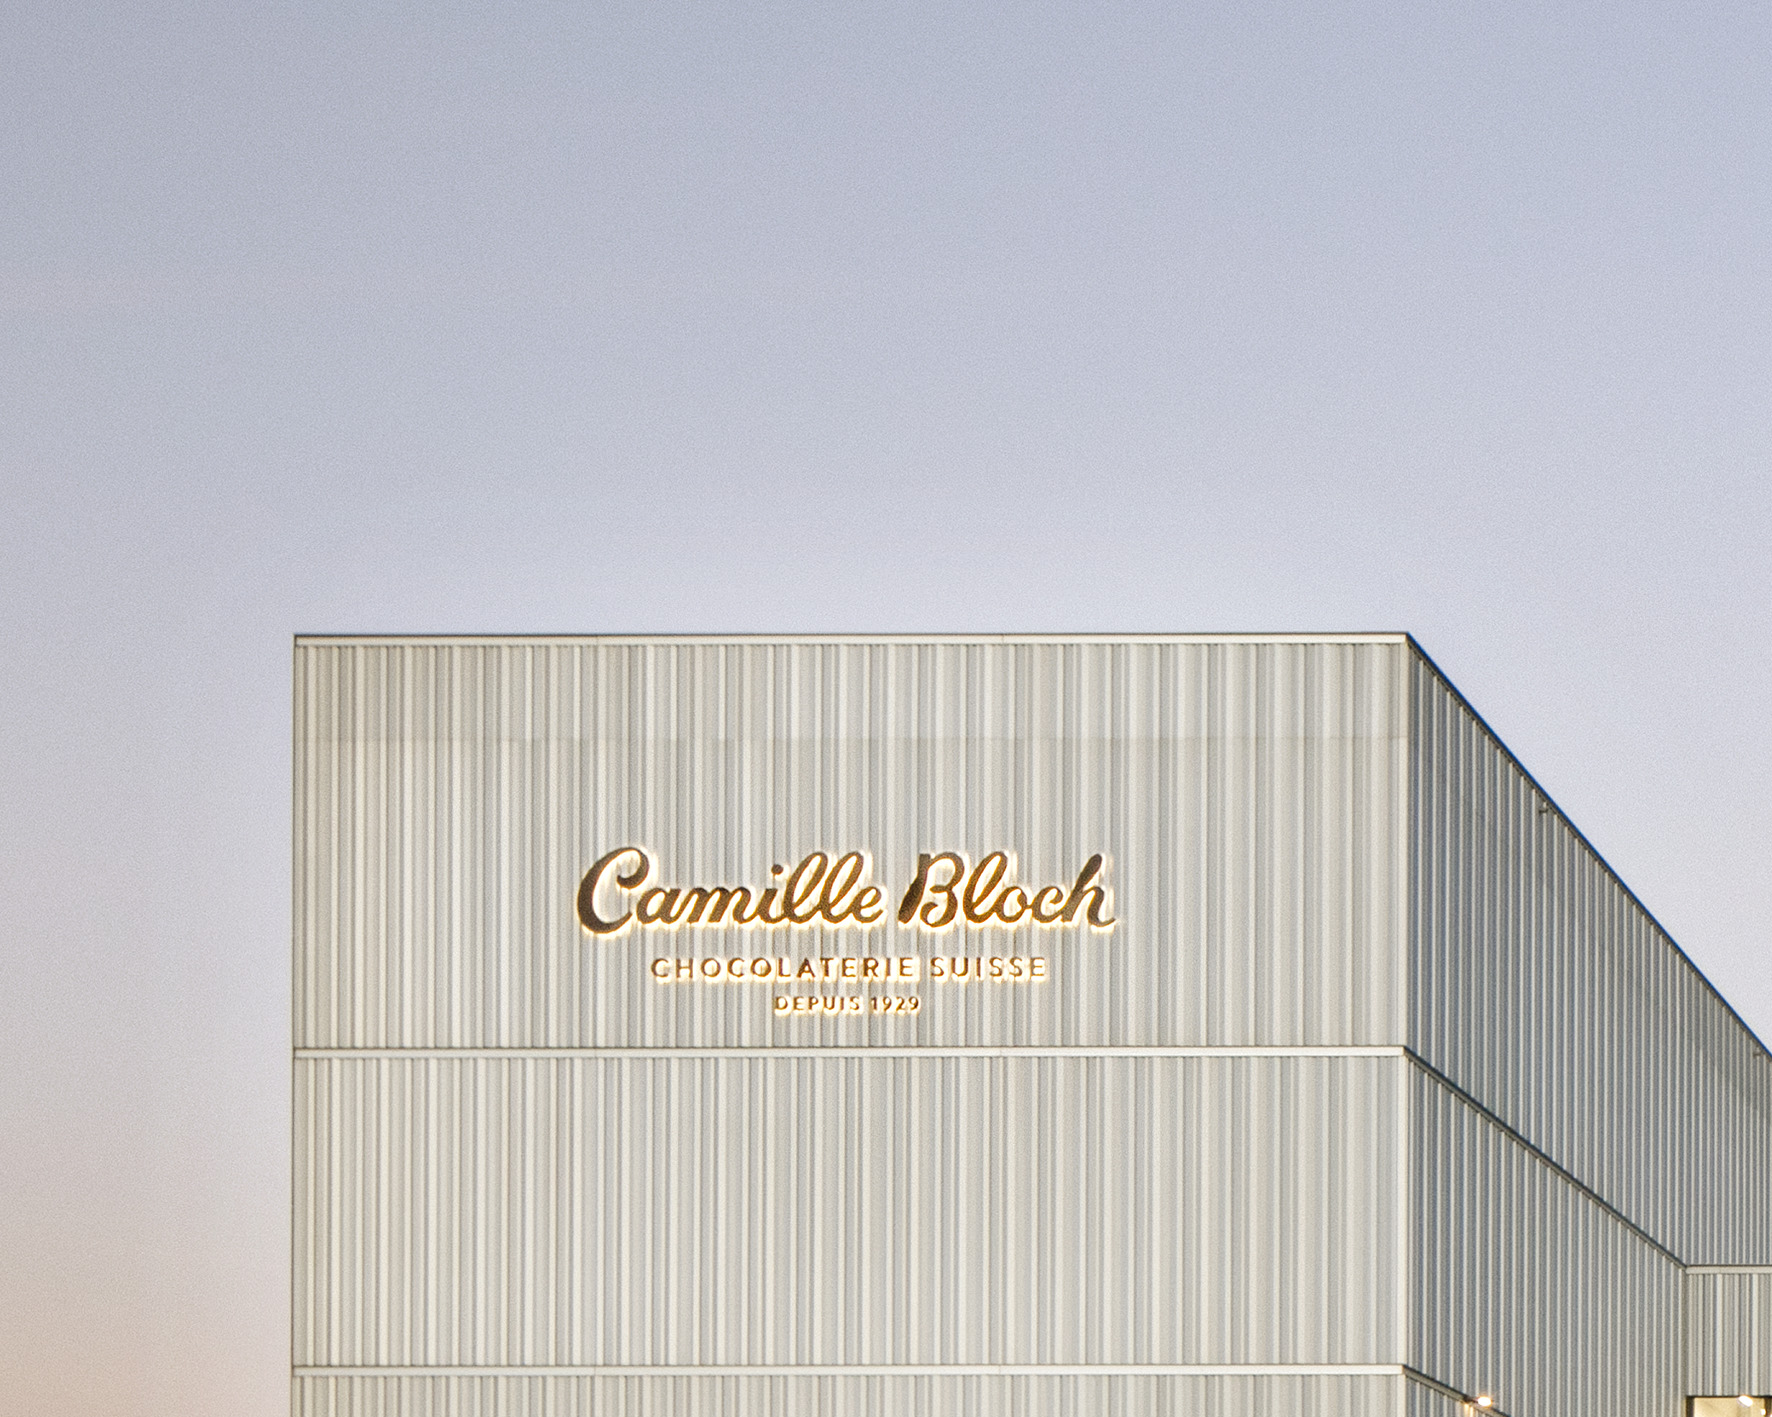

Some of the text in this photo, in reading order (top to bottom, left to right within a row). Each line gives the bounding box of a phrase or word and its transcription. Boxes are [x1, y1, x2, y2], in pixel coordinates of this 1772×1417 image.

[577, 847, 1117, 935] Camille Bloch
[651, 957, 1046, 979] CHOCOLATERIE SUISSE
[775, 996, 919, 1012] DEPUIS 1929
